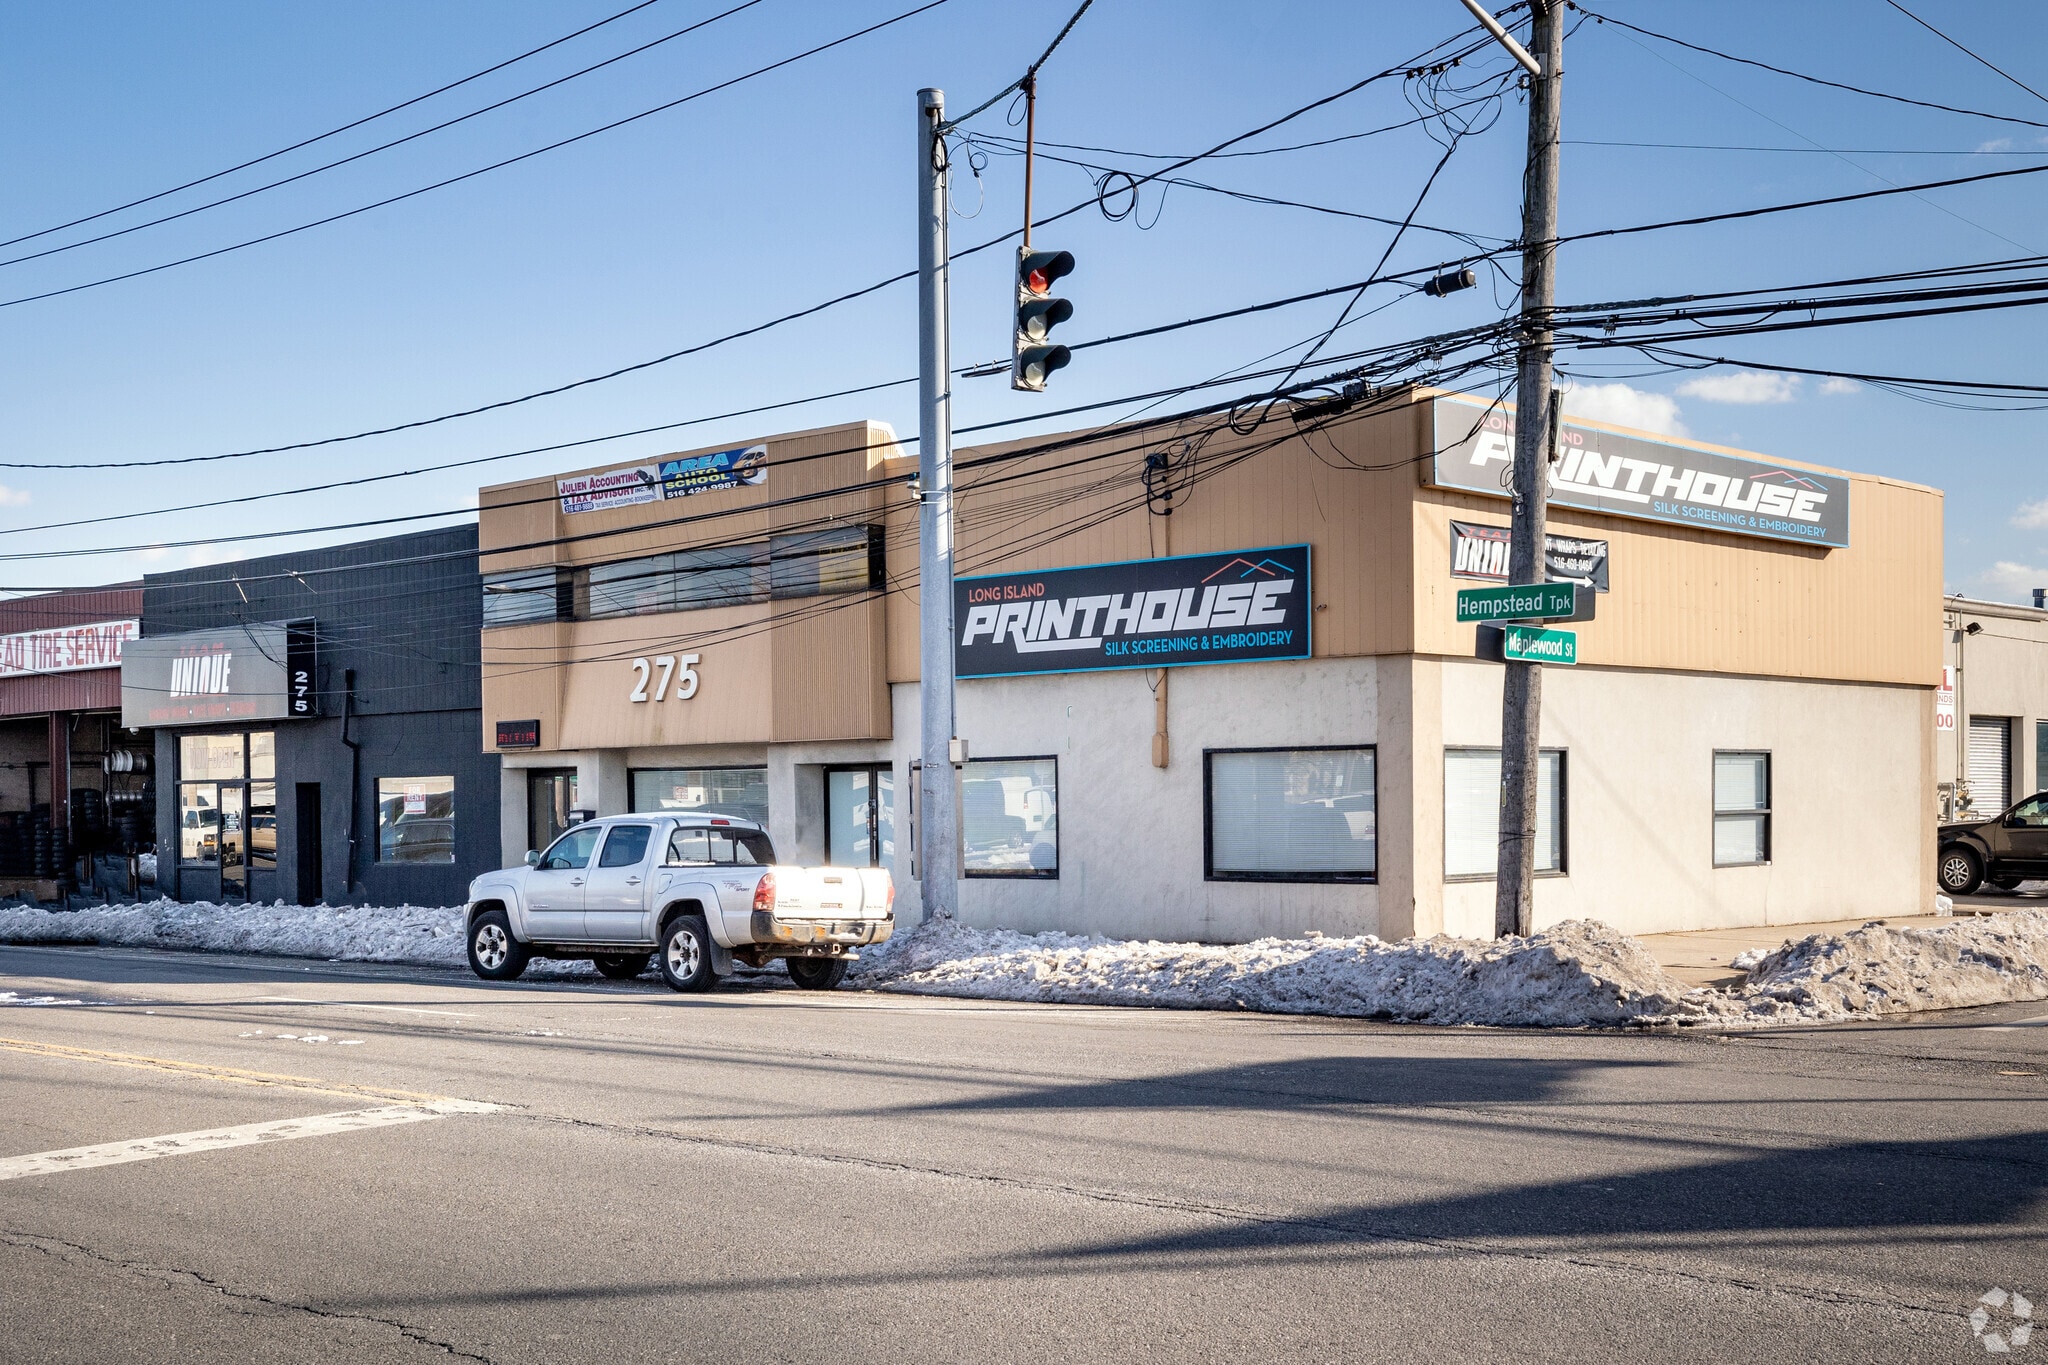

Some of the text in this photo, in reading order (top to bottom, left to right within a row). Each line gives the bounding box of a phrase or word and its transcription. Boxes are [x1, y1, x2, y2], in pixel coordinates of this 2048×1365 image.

[661, 453, 730, 476] AREA
[675, 467, 718, 480] AUTO
[561, 472, 640, 494] JULIEN ACCOUNTING
[665, 473, 731, 489] SCHOOL
[563, 497, 569, 505] &
[570, 492, 588, 504] TAX
[590, 487, 635, 501] ADVISORY
[667, 489, 686, 498] 516
[1653, 501, 1827, 538] SILK SCREENING & EMBROIDERY
[1454, 536, 1511, 576] UNIQ
[1556, 539, 1577, 554] WRAPS
[968, 582, 1045, 603] LONG ISLAND
[1458, 592, 1571, 617] Hempstead Tpk
[961, 578, 1295, 654] PRINTHOUSE
[29, 631, 62, 669] TIRE
[1105, 629, 1294, 656] SILK SCREENING & EMBROIDERY
[1508, 633, 1573, 657] Maplewood St
[170, 653, 232, 698] UNIQUE
[629, 653, 701, 703] 275
